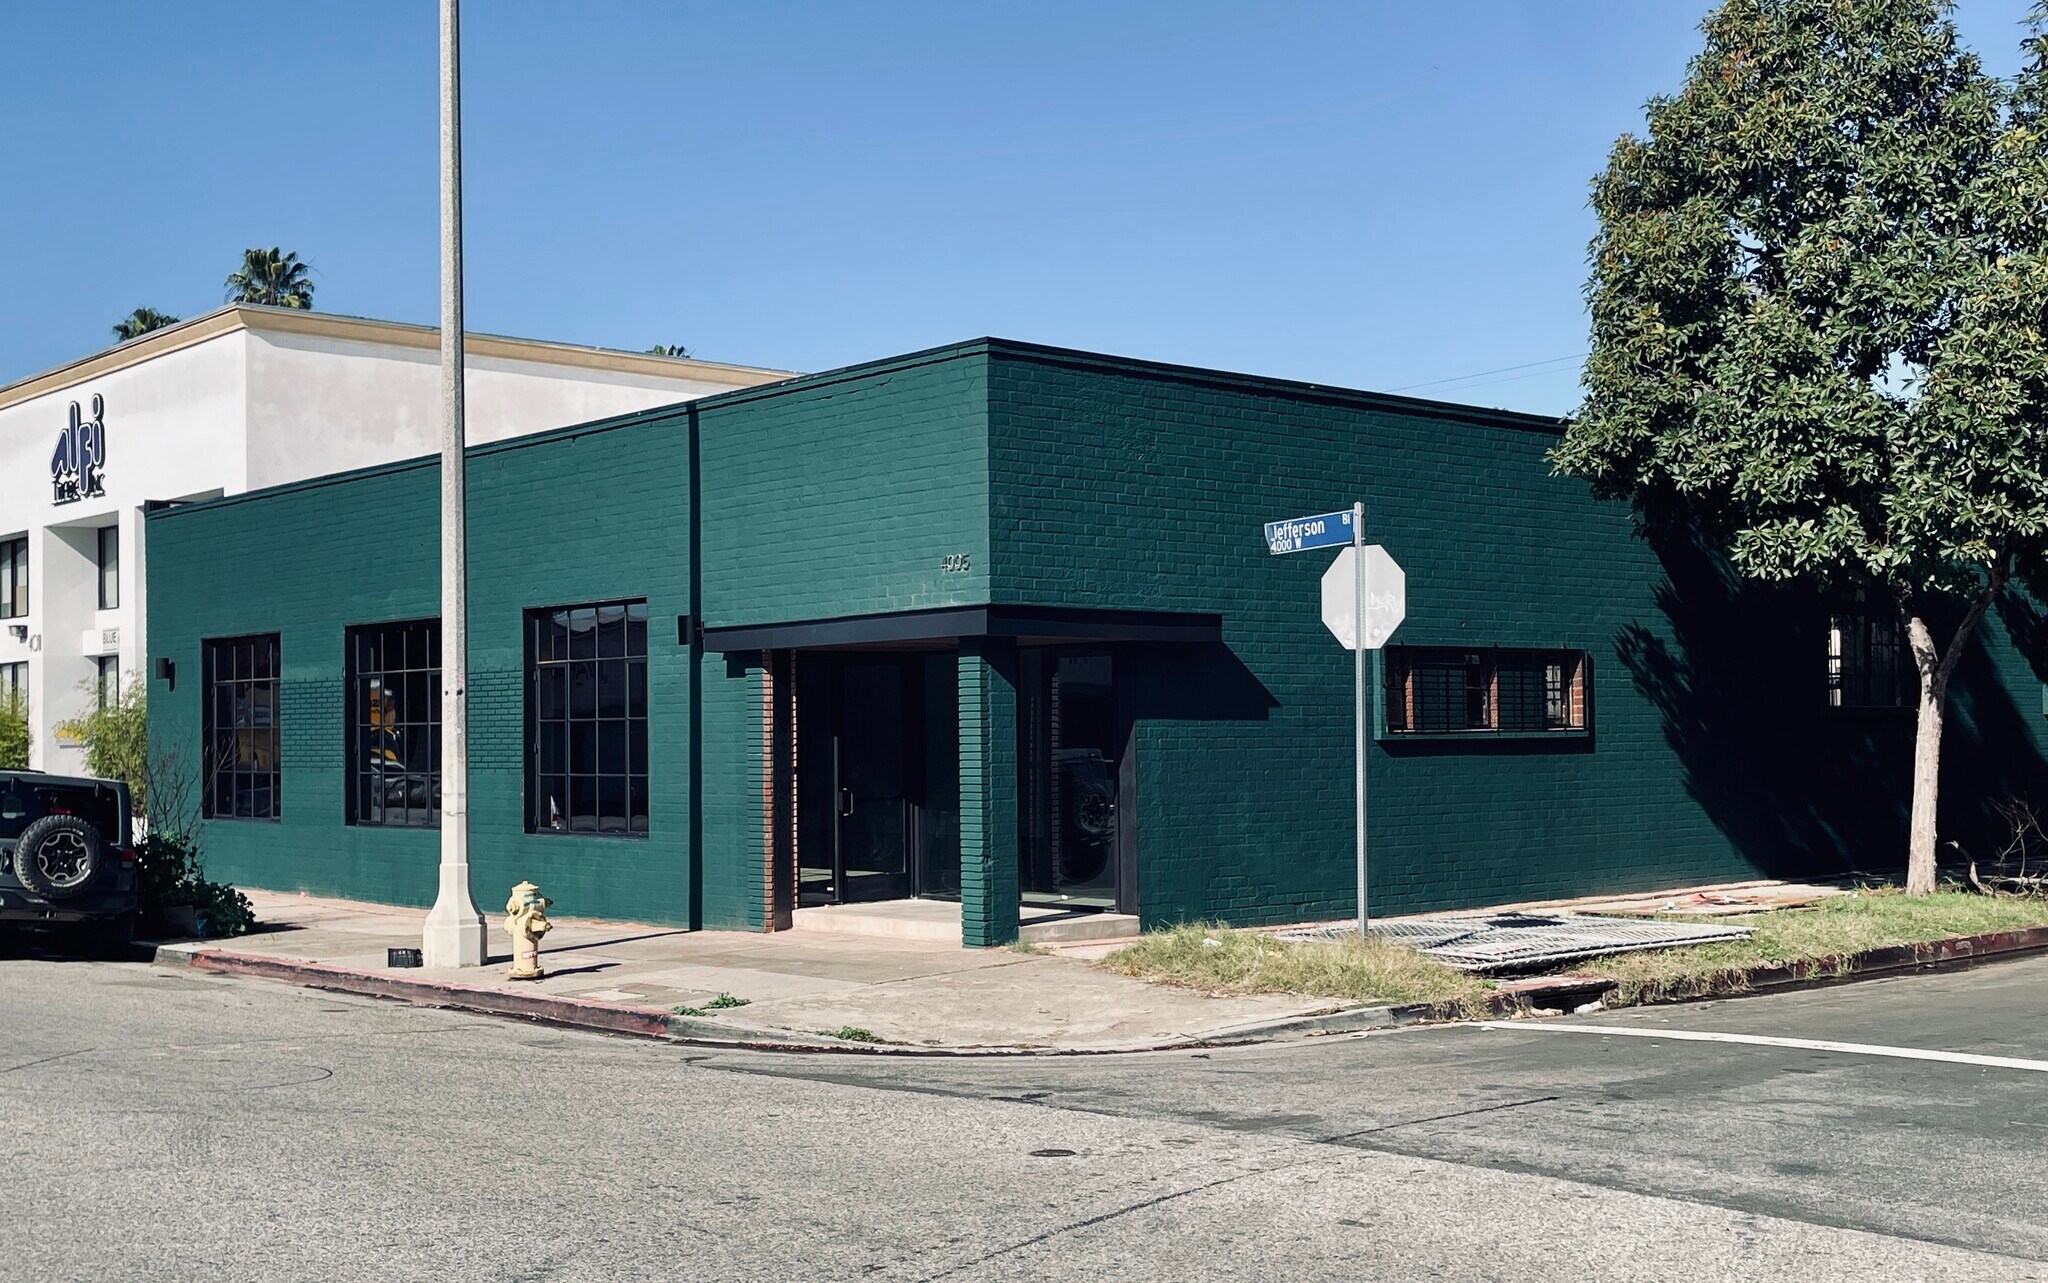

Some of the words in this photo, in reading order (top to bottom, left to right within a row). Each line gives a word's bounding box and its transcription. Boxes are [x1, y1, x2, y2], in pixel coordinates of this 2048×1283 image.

[1270, 520, 1325, 541] Jefferson
[1270, 538, 1292, 553] 4000
[1295, 536, 1302, 549] W
